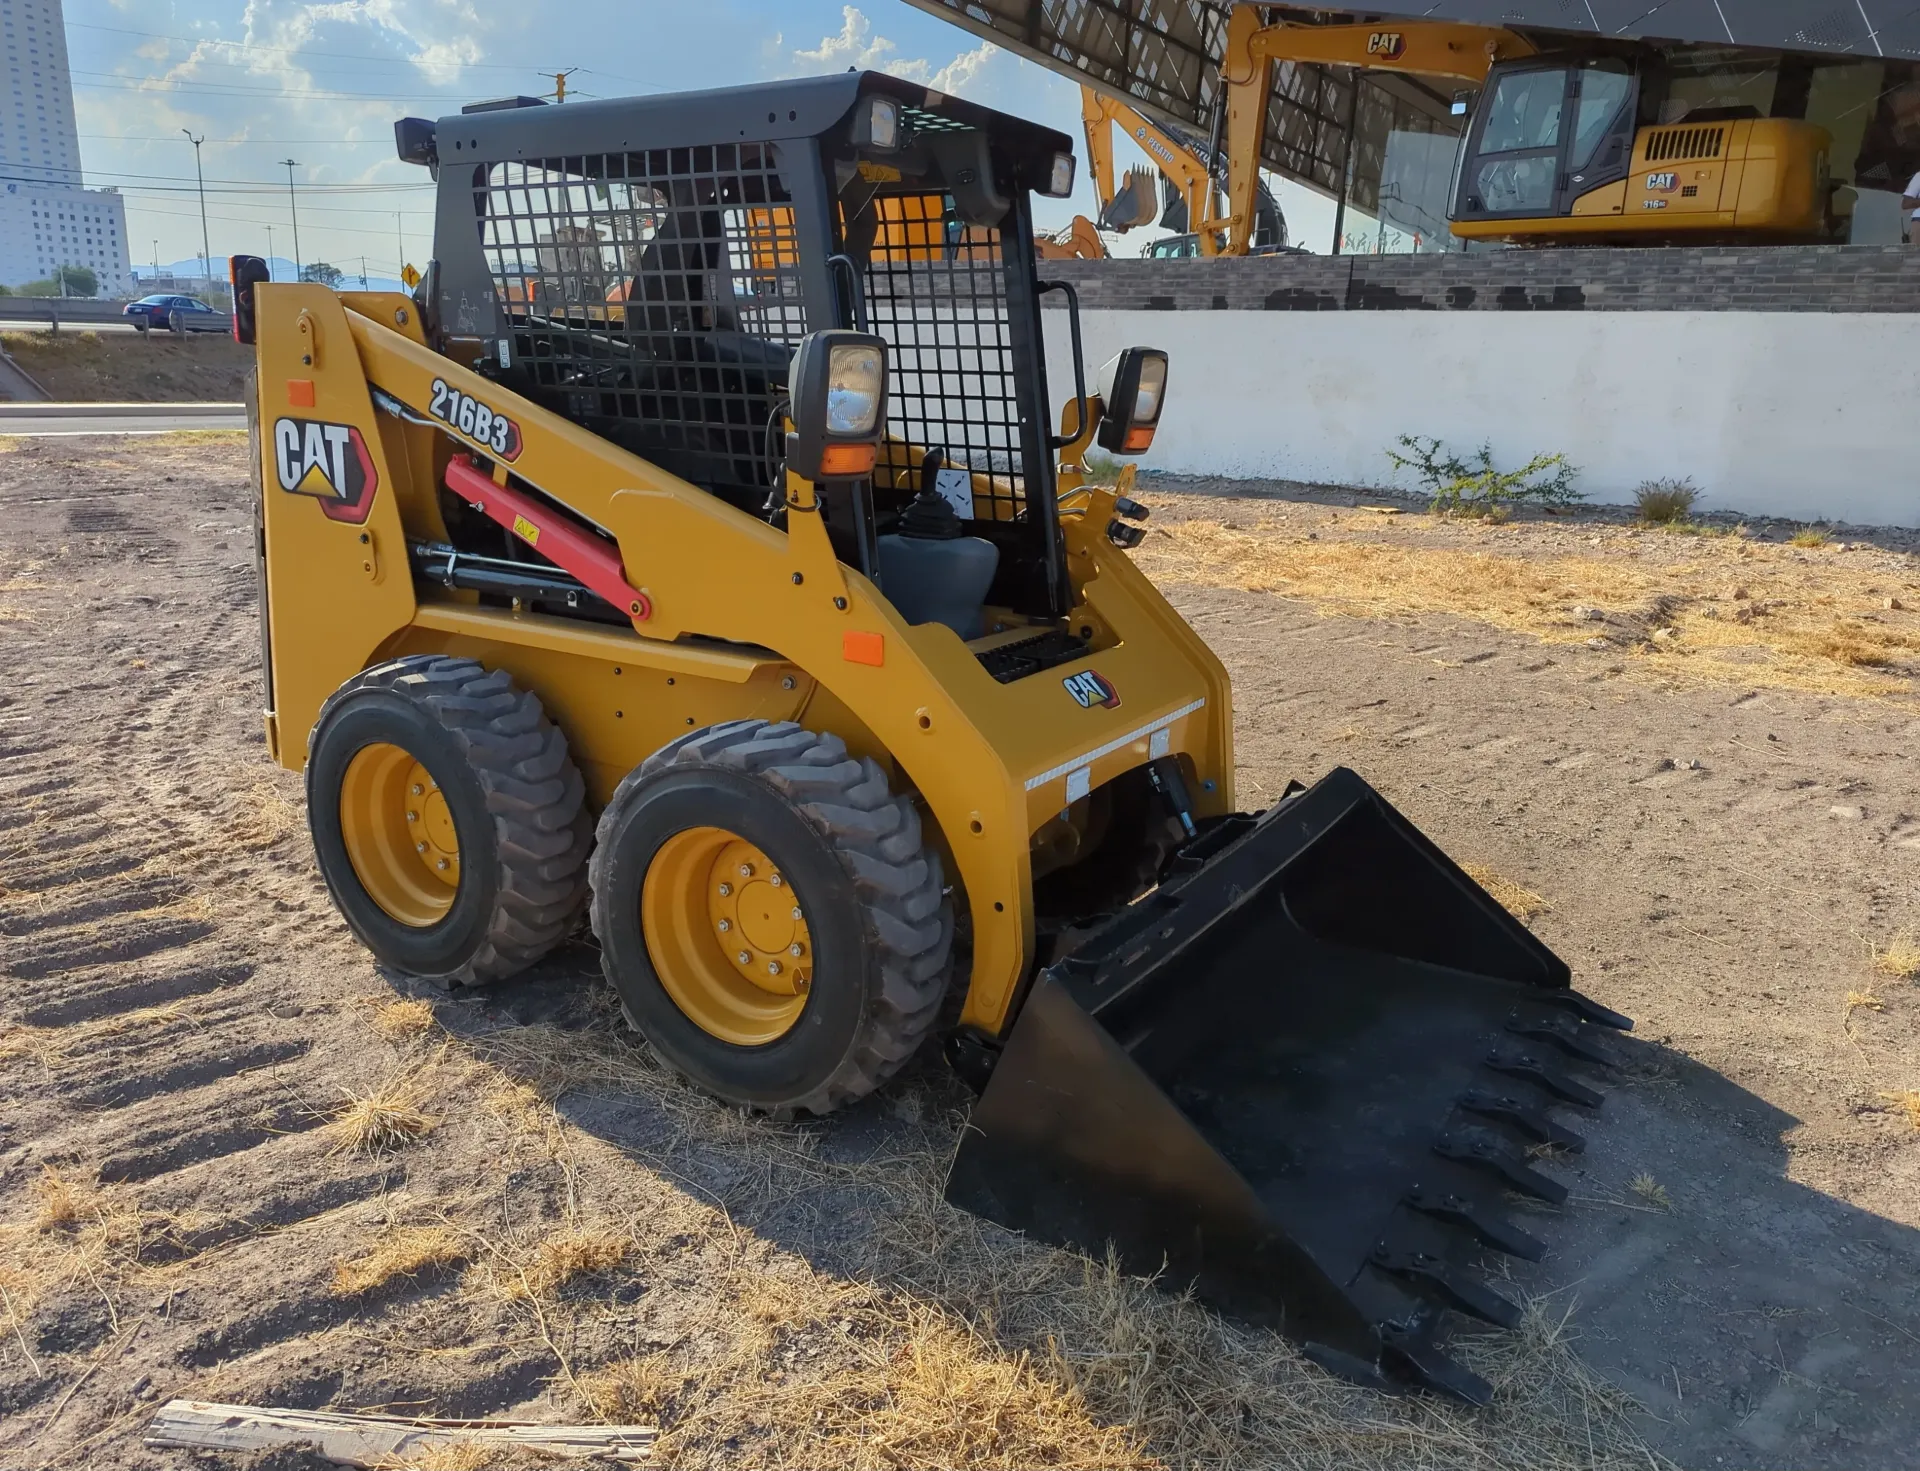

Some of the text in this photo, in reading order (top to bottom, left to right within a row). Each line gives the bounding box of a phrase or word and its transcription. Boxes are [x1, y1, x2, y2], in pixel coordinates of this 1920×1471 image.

[1367, 33, 1400, 54] CAT
[1147, 137, 1175, 164] PESATTO
[1646, 173, 1674, 190] CAT
[430, 379, 509, 453] 216B3
[275, 418, 350, 499] CAT
[1063, 671, 1109, 708] CAT
